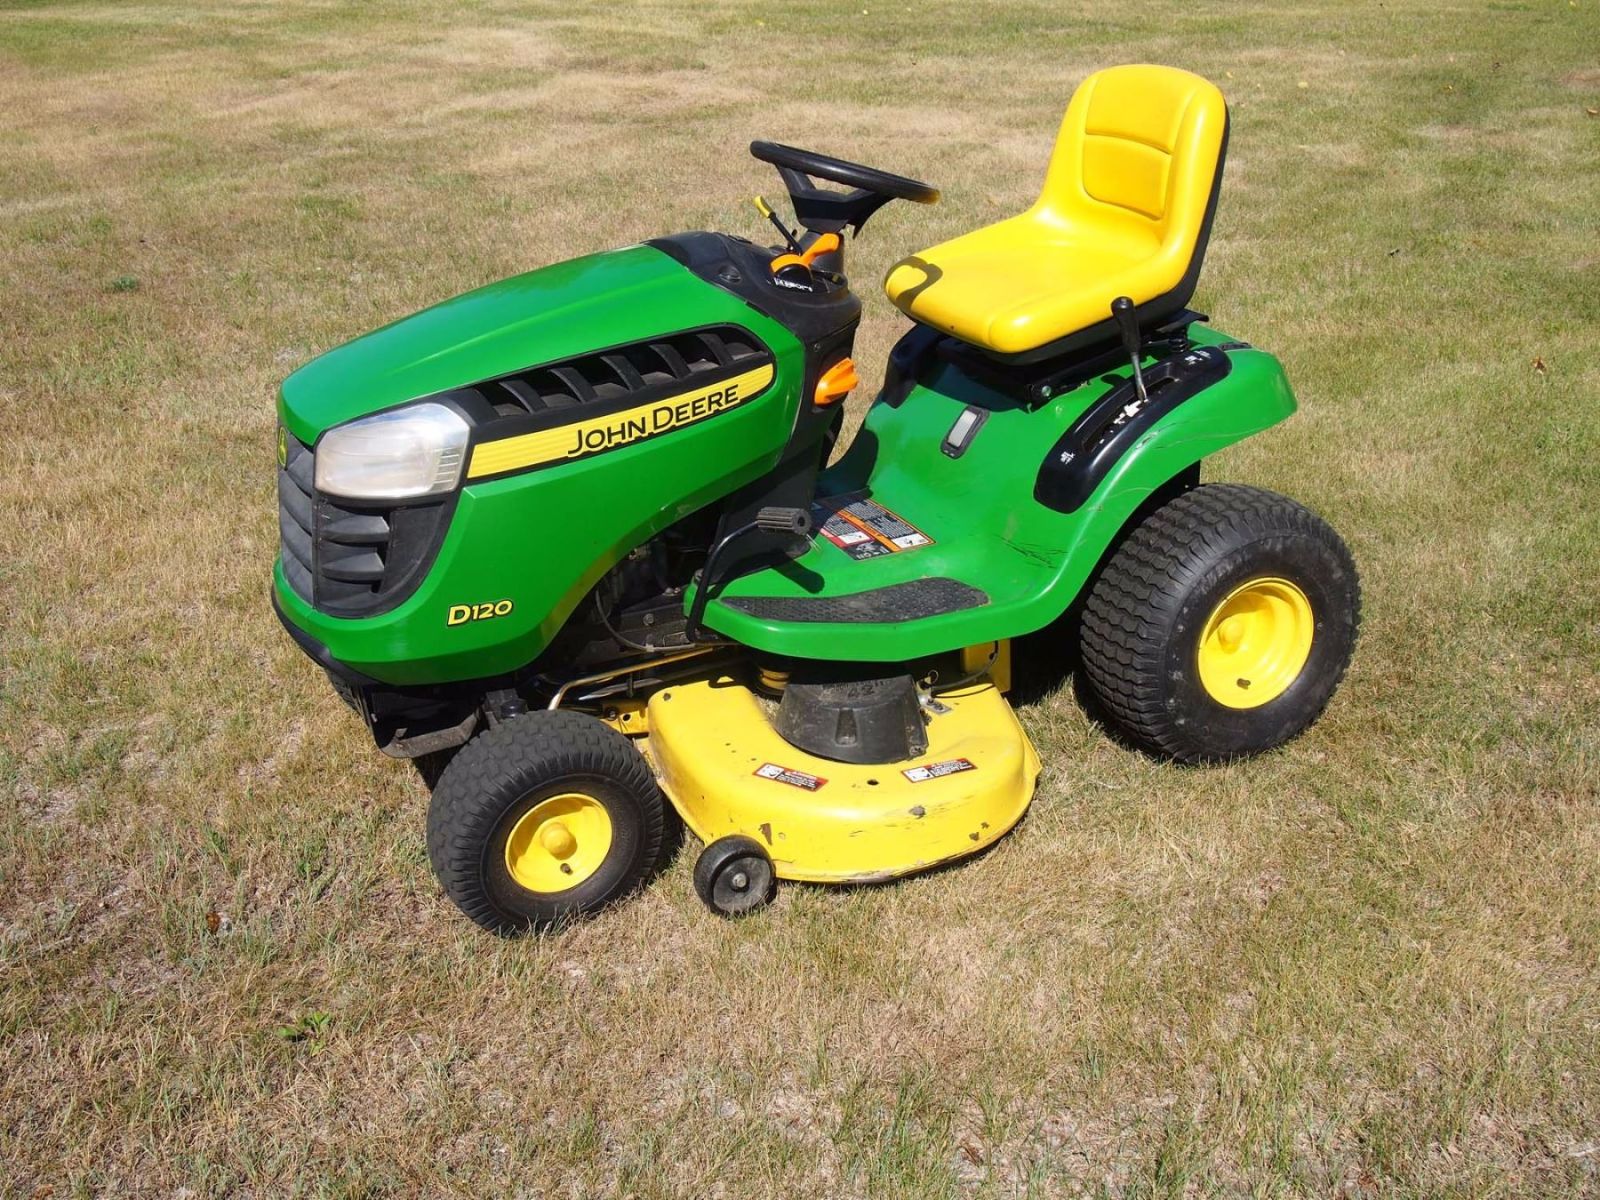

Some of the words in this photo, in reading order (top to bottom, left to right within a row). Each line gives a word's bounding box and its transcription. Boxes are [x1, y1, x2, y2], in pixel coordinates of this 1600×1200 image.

[567, 416, 646, 455] JOHN
[653, 384, 739, 431] DEERE
[447, 600, 513, 626] D120
